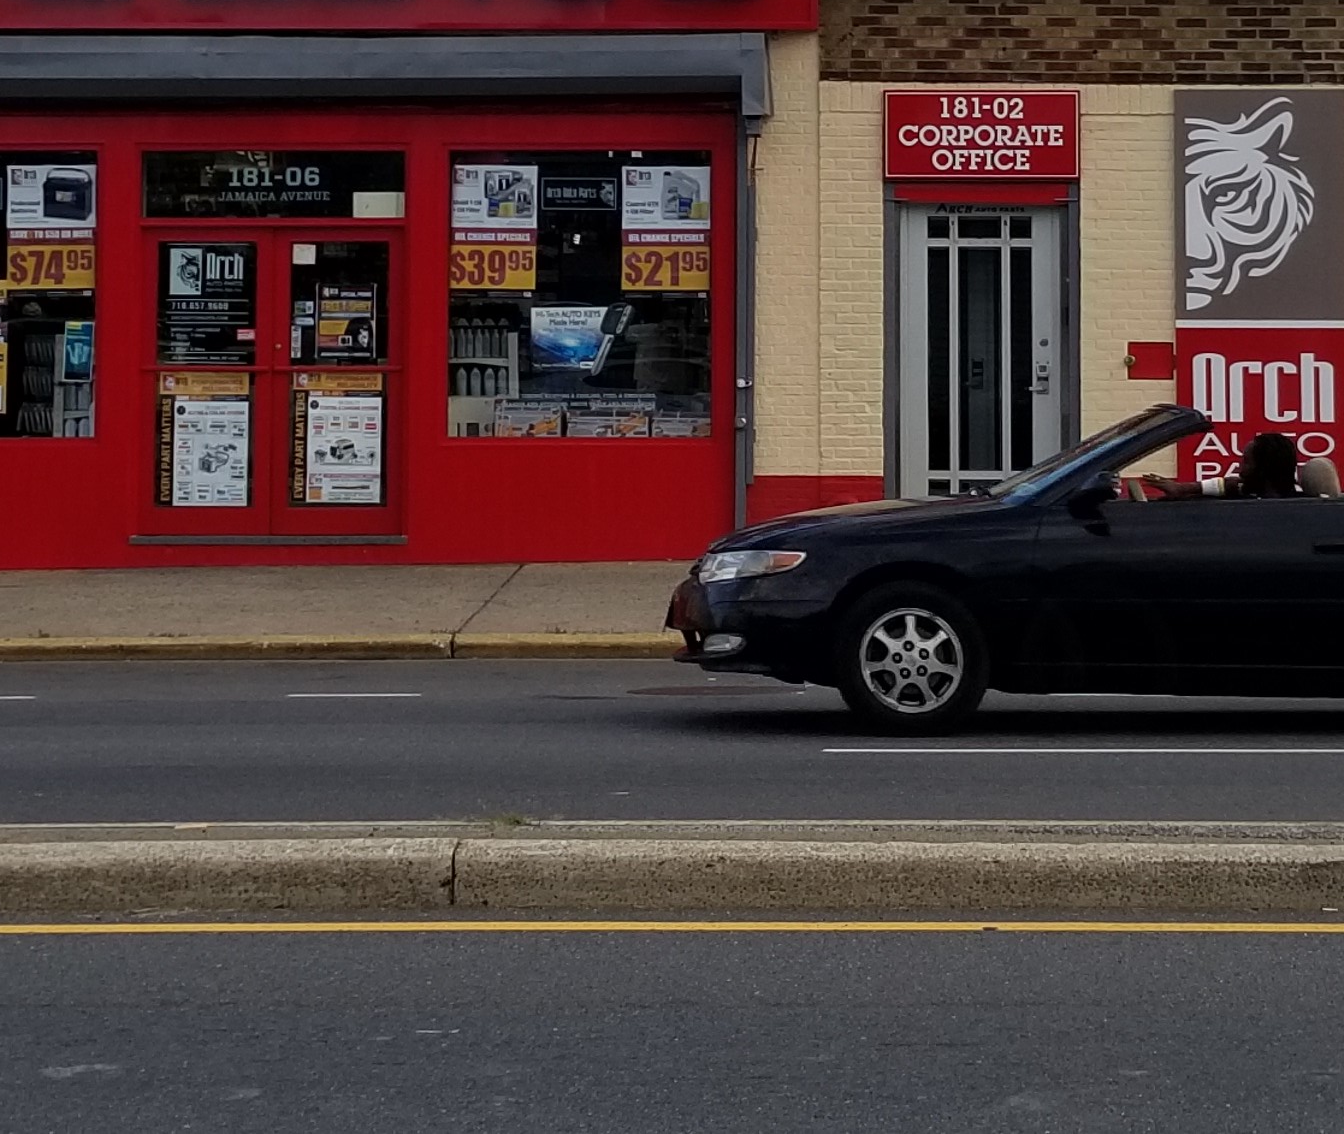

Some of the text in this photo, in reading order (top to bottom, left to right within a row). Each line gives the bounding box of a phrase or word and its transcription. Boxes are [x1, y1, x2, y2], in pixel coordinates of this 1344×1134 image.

[939, 96, 1025, 120] 181-02
[898, 124, 1064, 147] CORPORATE
[931, 149, 1031, 171] OFFICE
[227, 166, 321, 187] 181-06
[217, 191, 331, 202] JAMAICA AVENUE
[206, 252, 244, 280] Arch
[1192, 352, 1336, 423] Arch
[161, 398, 172, 443] MATTERS
[160, 444, 171, 470] PART
[294, 439, 305, 465] PART
[1193, 432, 1336, 458] AO
